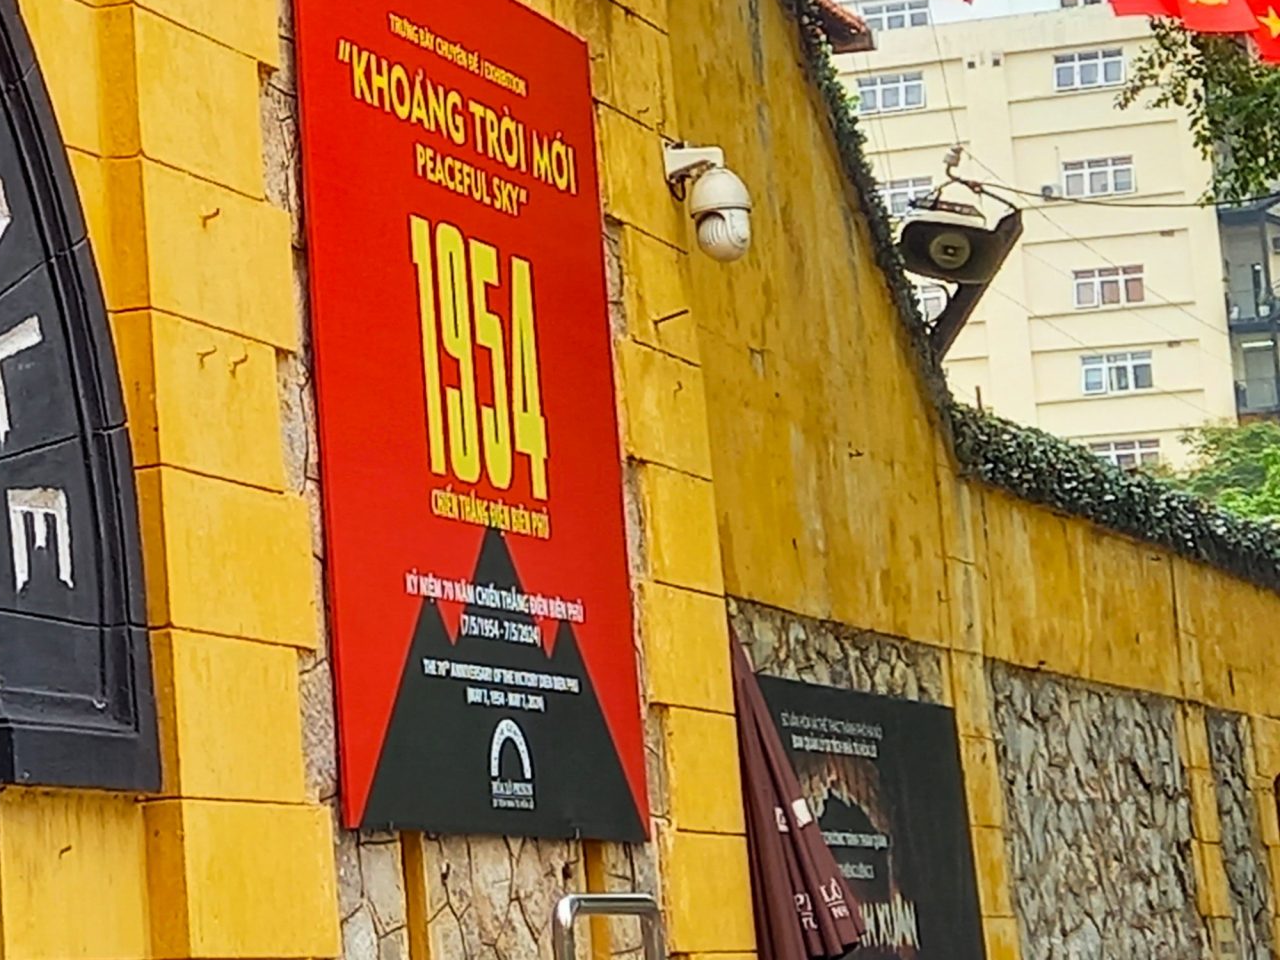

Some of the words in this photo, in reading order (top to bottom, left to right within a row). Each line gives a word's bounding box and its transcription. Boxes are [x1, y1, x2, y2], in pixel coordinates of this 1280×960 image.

[415, 142, 492, 205] PEACEFUL
[492, 175, 528, 216] SKY"
[468, 104, 527, 173] TRỜI
[532, 130, 577, 196] MỚI
[409, 214, 548, 501] 1954
[442, 579, 455, 601] 70
